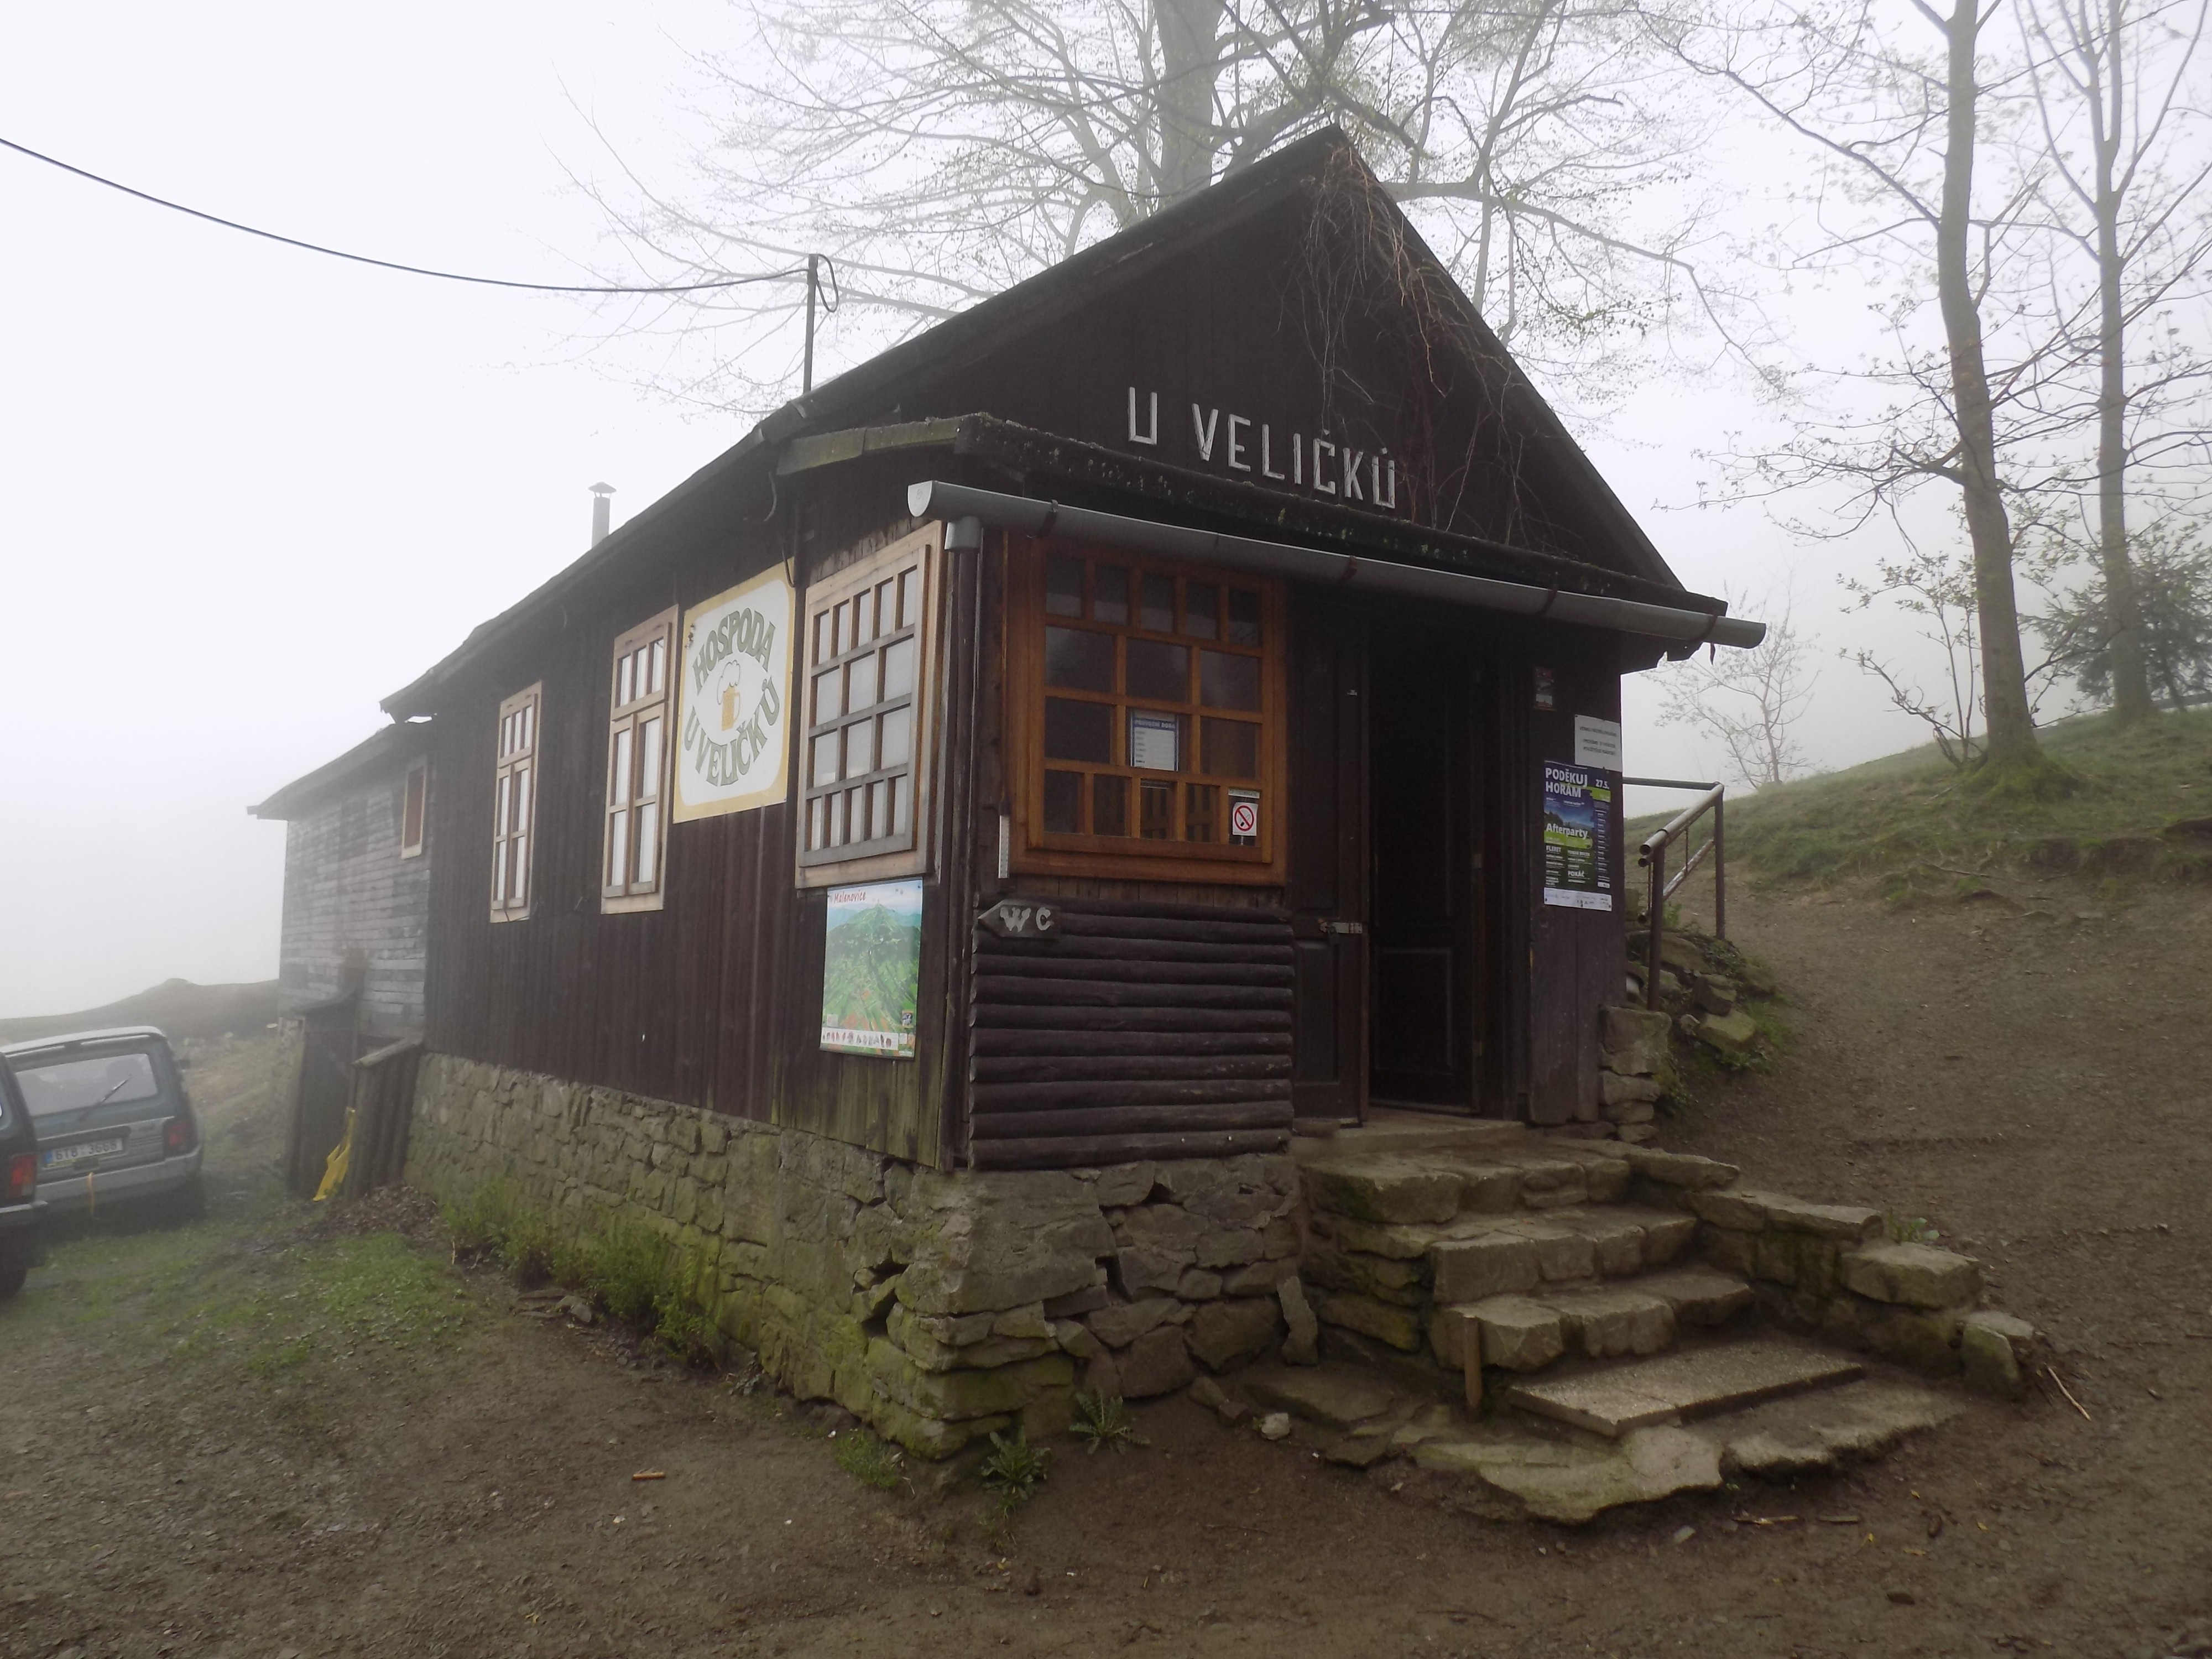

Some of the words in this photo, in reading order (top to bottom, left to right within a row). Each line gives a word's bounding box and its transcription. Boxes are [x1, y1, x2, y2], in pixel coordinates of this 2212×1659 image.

[1128, 387, 1157, 445] U
[1191, 403, 1396, 509] VELIČKŮ
[692, 607, 776, 696] HOSPODA
[684, 705, 700, 752] U
[695, 676, 780, 787] VELIČKŮ
[1545, 767, 1588, 787] PODĚKUJ
[1595, 779, 1610, 790] 27.5.
[1545, 781, 1582, 798] HORÁM
[1546, 823, 1588, 839] Afterparty
[834, 889, 866, 904] Malenovice
